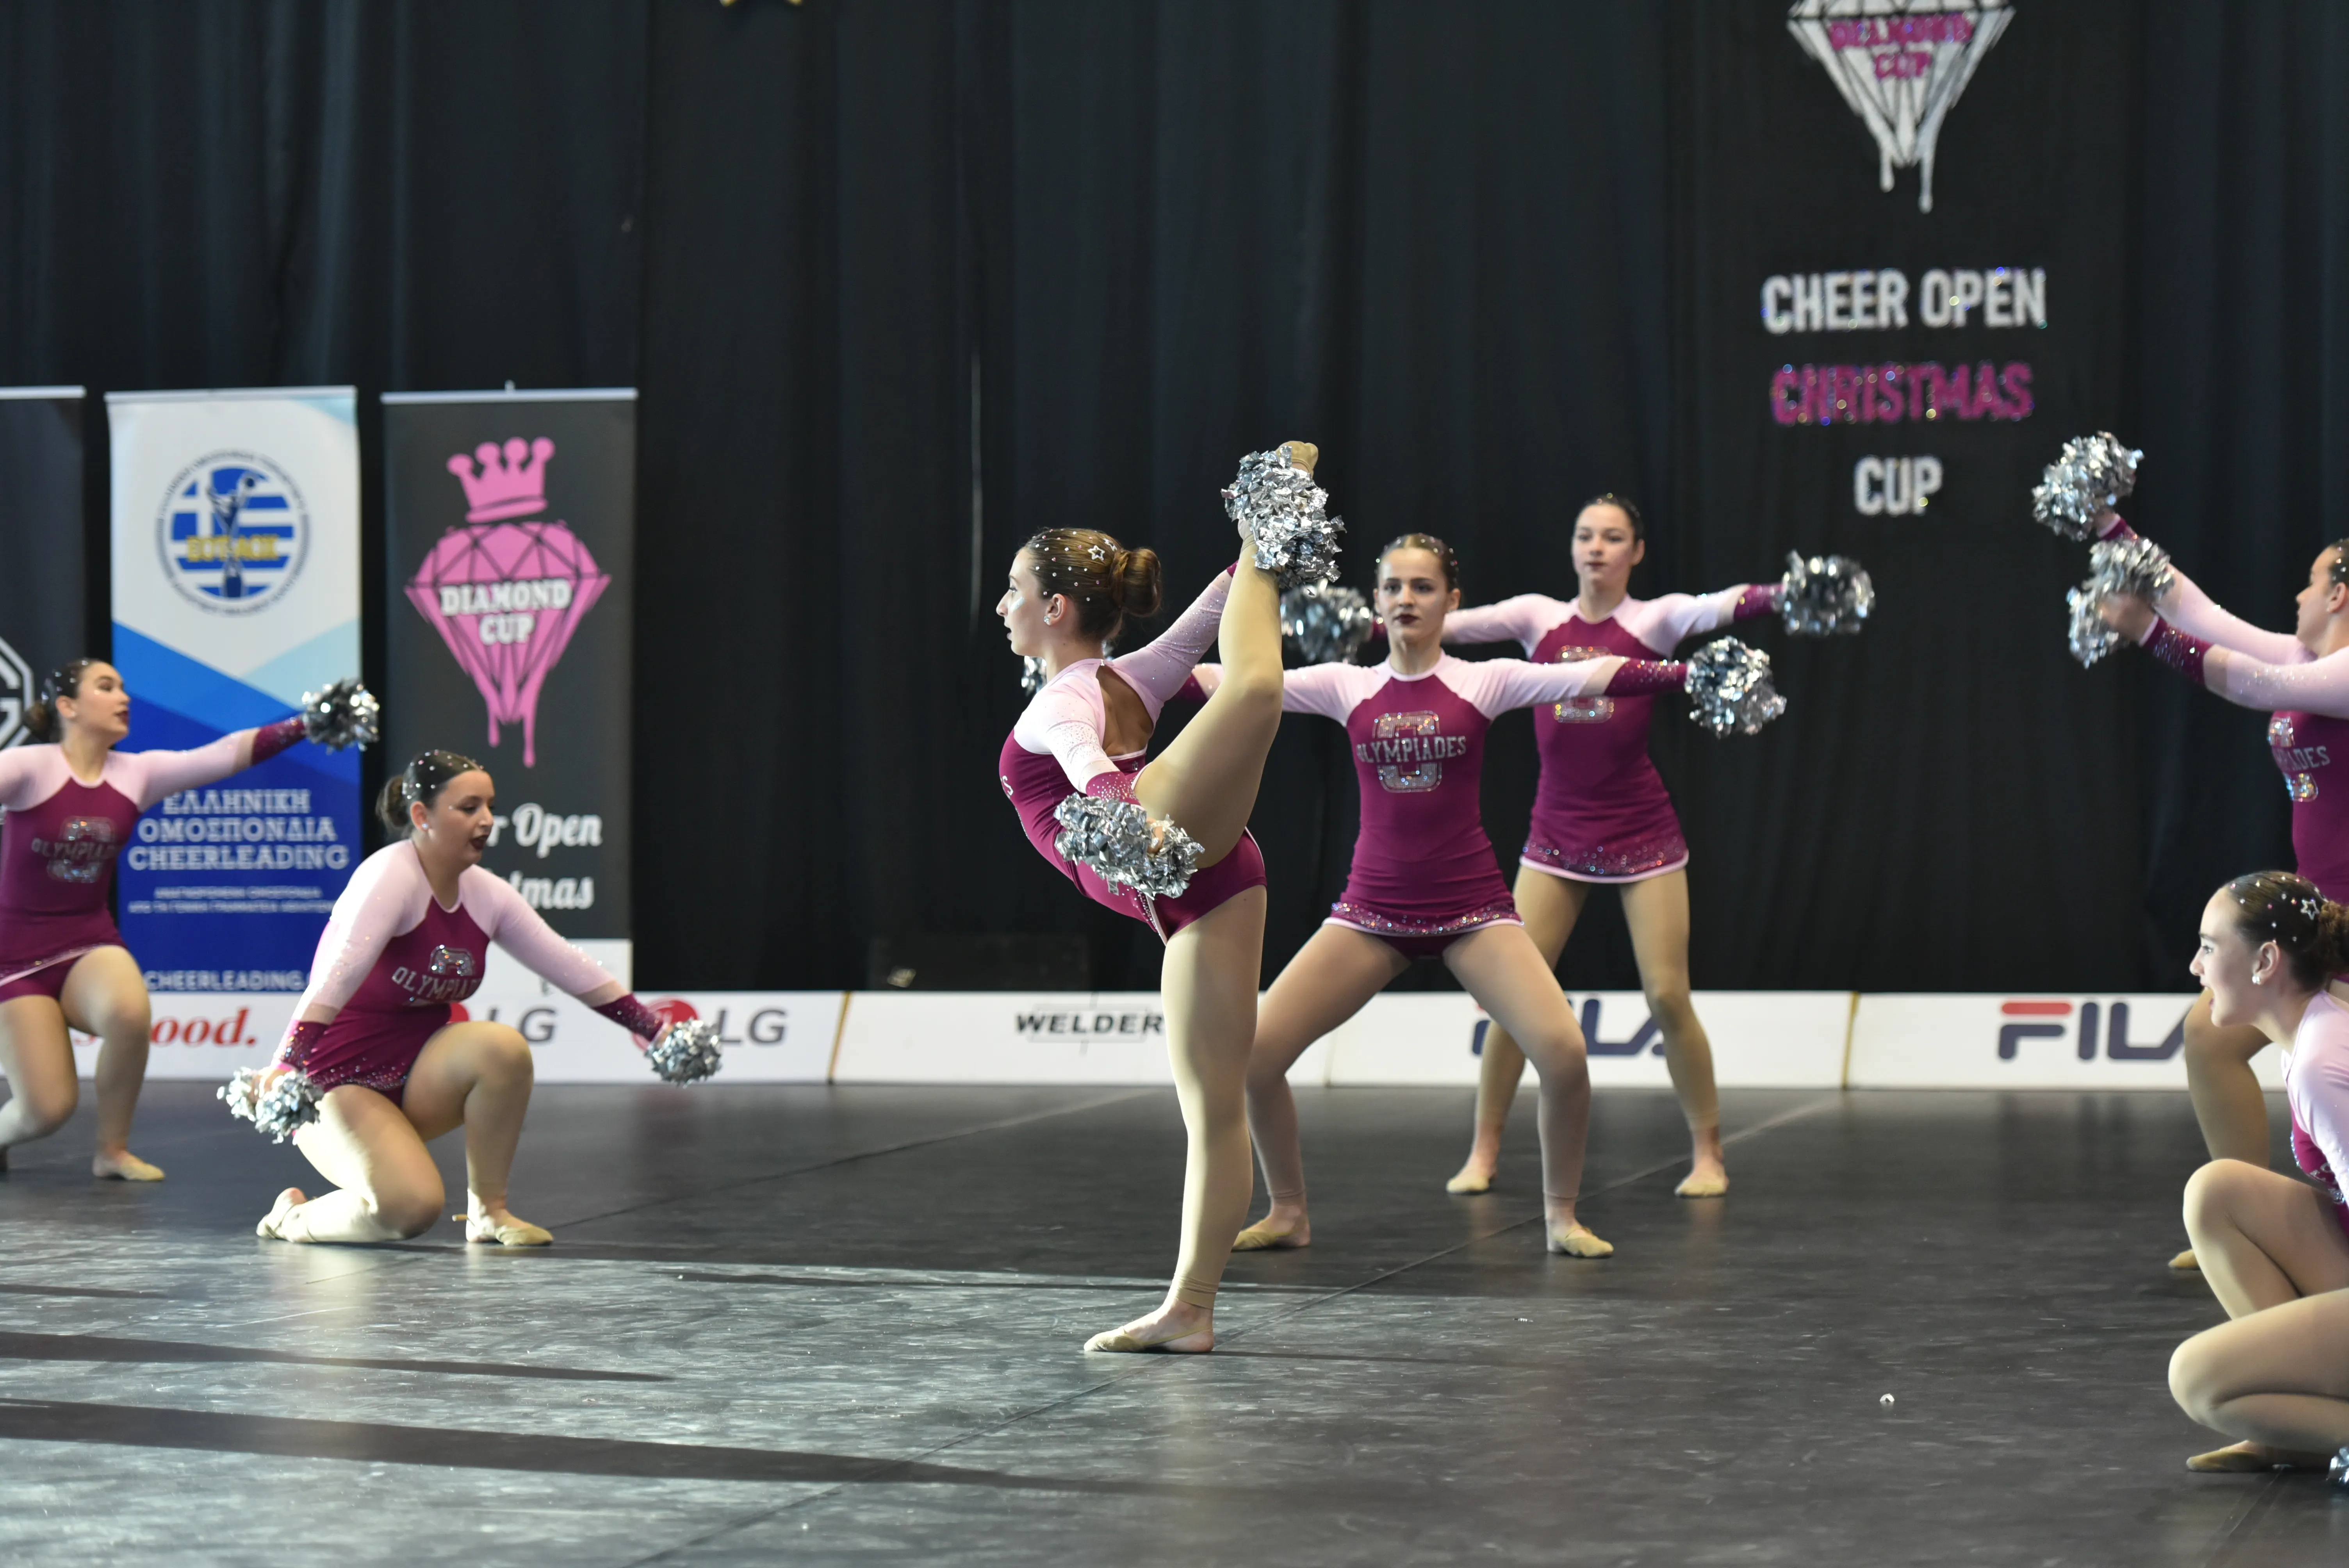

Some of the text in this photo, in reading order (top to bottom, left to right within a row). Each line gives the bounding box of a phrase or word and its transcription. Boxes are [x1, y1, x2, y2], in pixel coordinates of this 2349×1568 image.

[1762, 267, 2047, 334] CHEER OPEN
[1772, 361, 2032, 424] CHRISTMAS
[1854, 454, 1943, 515] CUP
[440, 578, 572, 616] DIAMOND
[479, 613, 534, 645] CUP
[1356, 735, 1467, 763] OLYMPIADES
[162, 789, 311, 814] ΕΛΛΗΝΙΚΗ
[137, 817, 338, 843] ΟΜΟΣΠΟΝΔΙΑ
[512, 802, 603, 859] Open
[127, 845, 350, 870] CHEERLEADING
[151, 1005, 258, 1047] ood.
[714, 1007, 789, 1044] LG
[1016, 1014, 1163, 1035] WELDER
